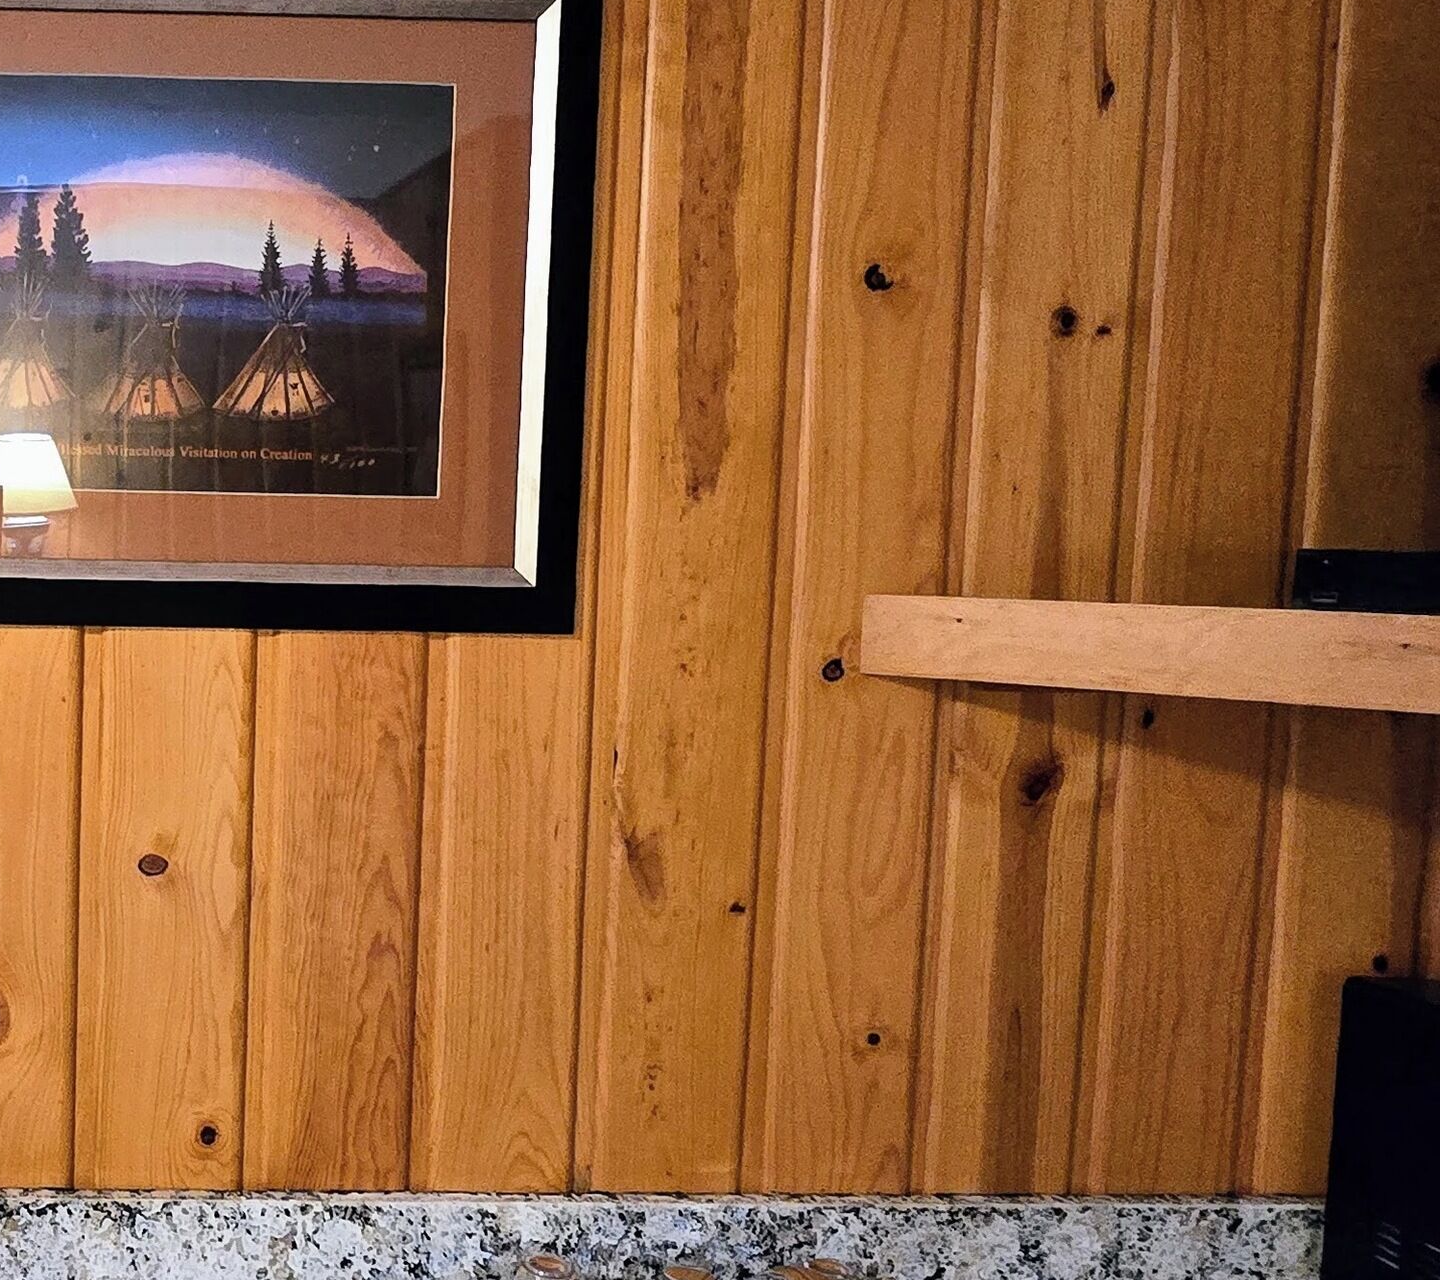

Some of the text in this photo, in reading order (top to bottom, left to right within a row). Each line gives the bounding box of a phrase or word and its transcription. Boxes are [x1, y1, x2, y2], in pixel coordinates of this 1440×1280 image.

[107, 445, 175, 458] Miraculous
[179, 446, 238, 460] Visitation
[241, 450, 257, 460] on
[260, 449, 313, 462] Creation
